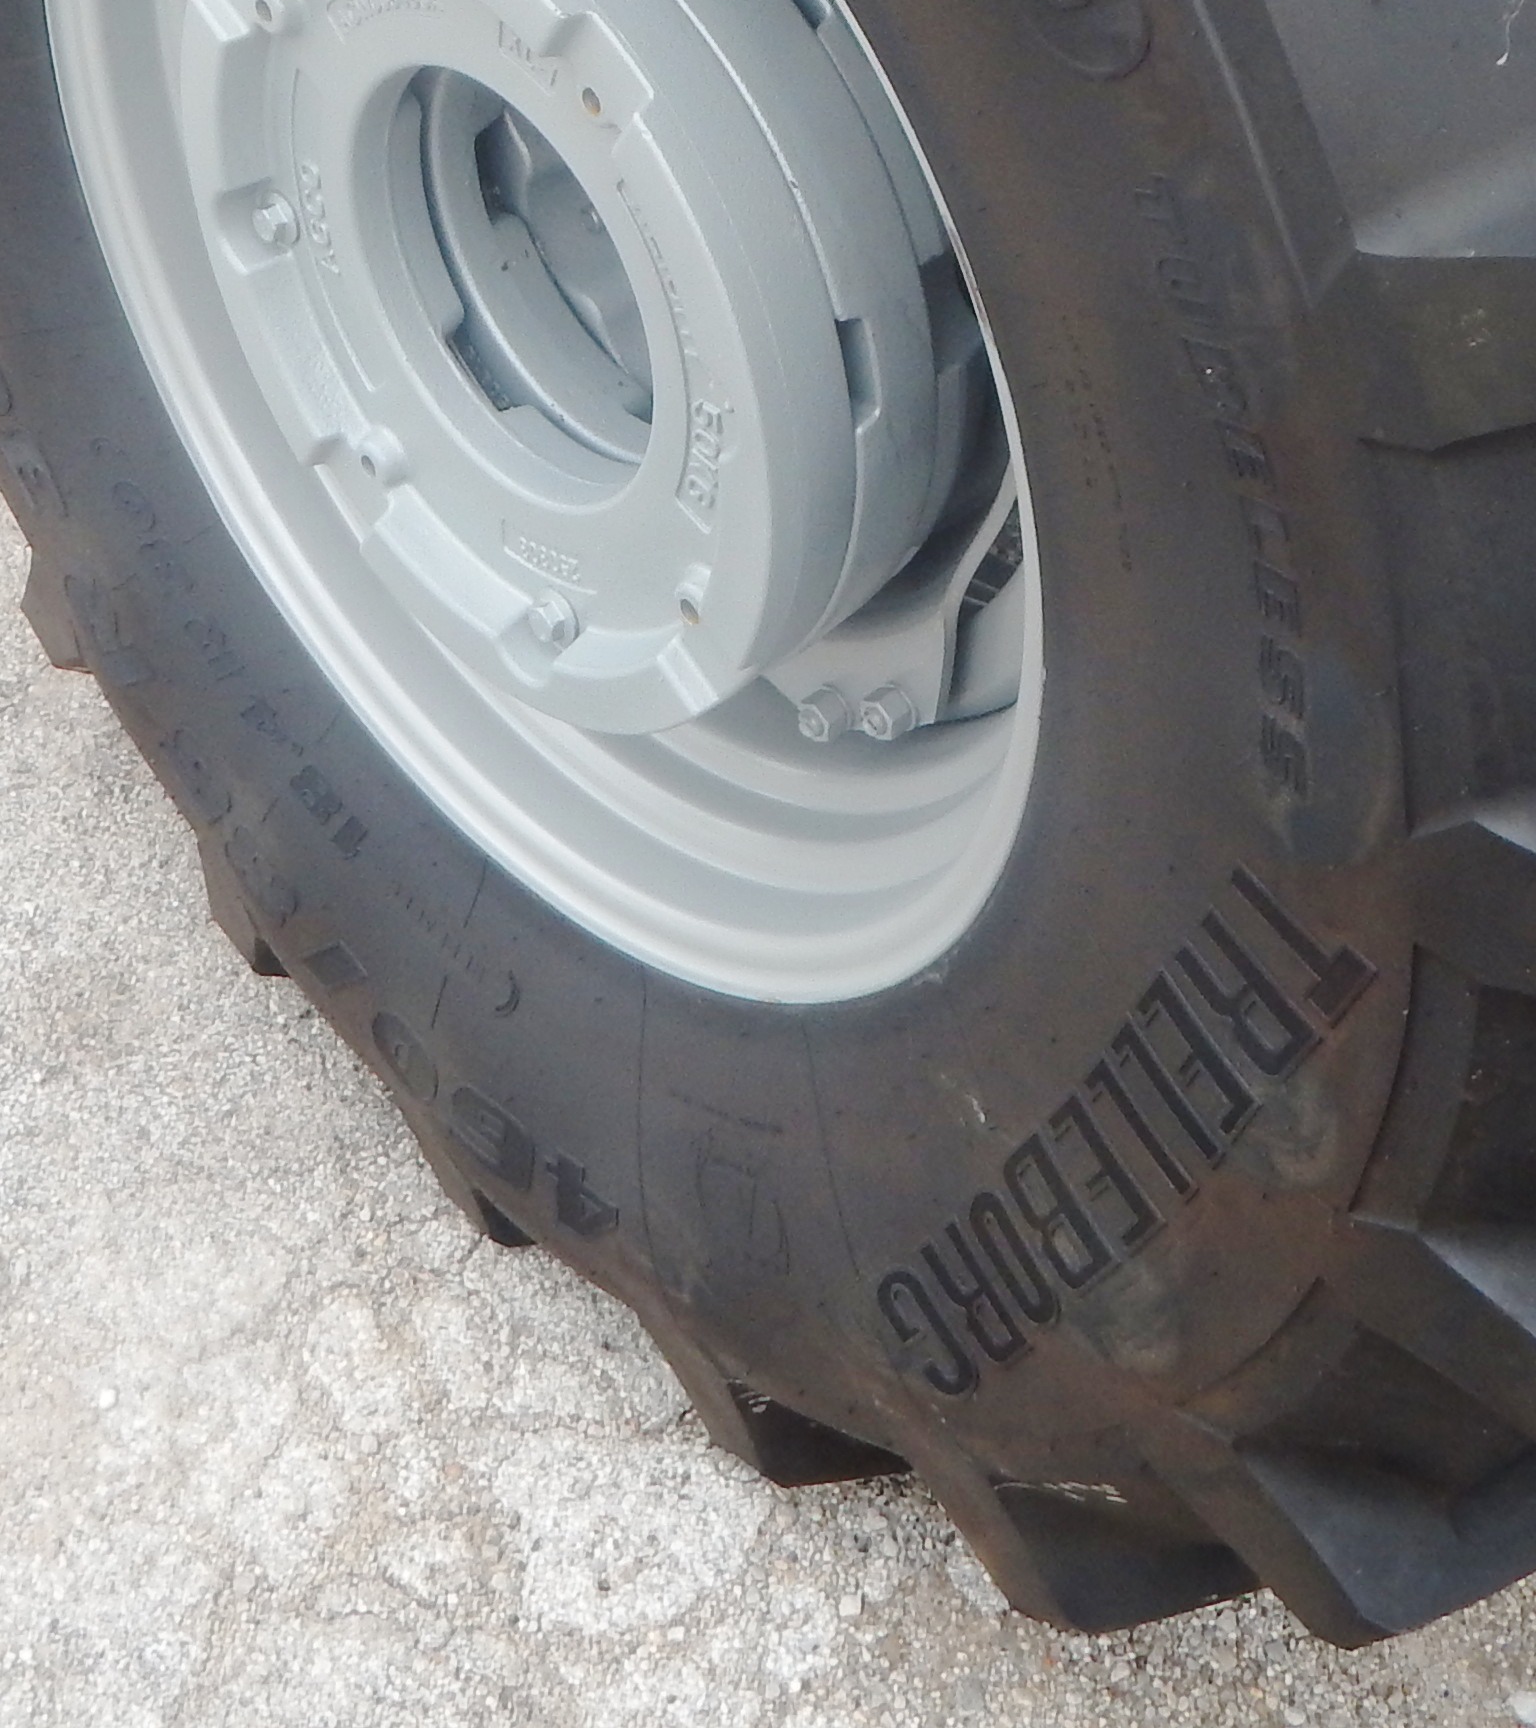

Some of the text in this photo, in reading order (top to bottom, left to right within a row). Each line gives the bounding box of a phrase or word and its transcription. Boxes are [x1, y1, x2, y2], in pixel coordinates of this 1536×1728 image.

[301, 159, 342, 276] AGCO
[680, 398, 726, 512] 50KG
[1134, 175, 1311, 798] TUBELESS
[874, 862, 1379, 1398] TRELLEBORG
